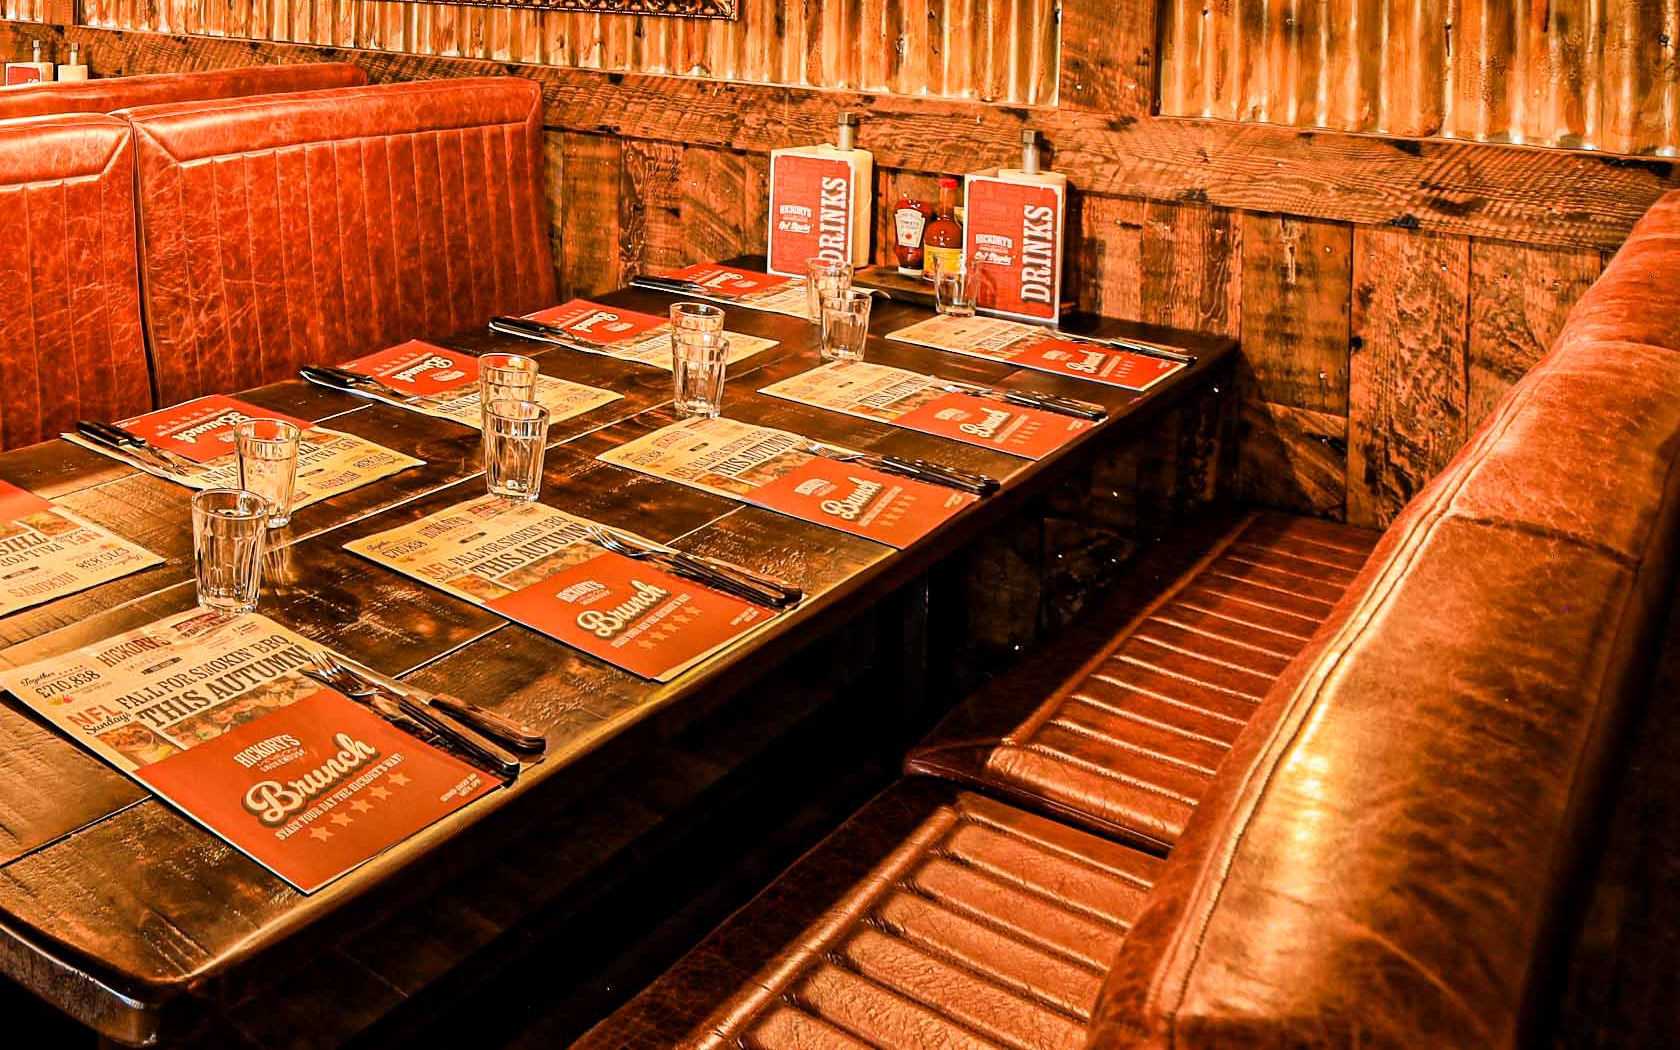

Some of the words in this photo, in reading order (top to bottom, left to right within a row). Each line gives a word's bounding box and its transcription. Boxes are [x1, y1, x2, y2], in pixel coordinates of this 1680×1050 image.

[818, 176, 848, 263] DRINKS
[1020, 204, 1054, 303] DRINKS
[468, 552, 526, 579] THIS
[576, 579, 669, 638] Brunch
[95, 635, 173, 668] HICKORY'S
[35, 669, 101, 699] £710,838
[115, 686, 166, 710] FALL
[158, 672, 200, 695] FOR
[248, 634, 296, 655] BBQ
[66, 704, 126, 728] NFL
[134, 689, 212, 728] THIS
[233, 733, 303, 769] HICKORY'S
[245, 732, 377, 823] Brunch
[318, 795, 339, 813] DAY
